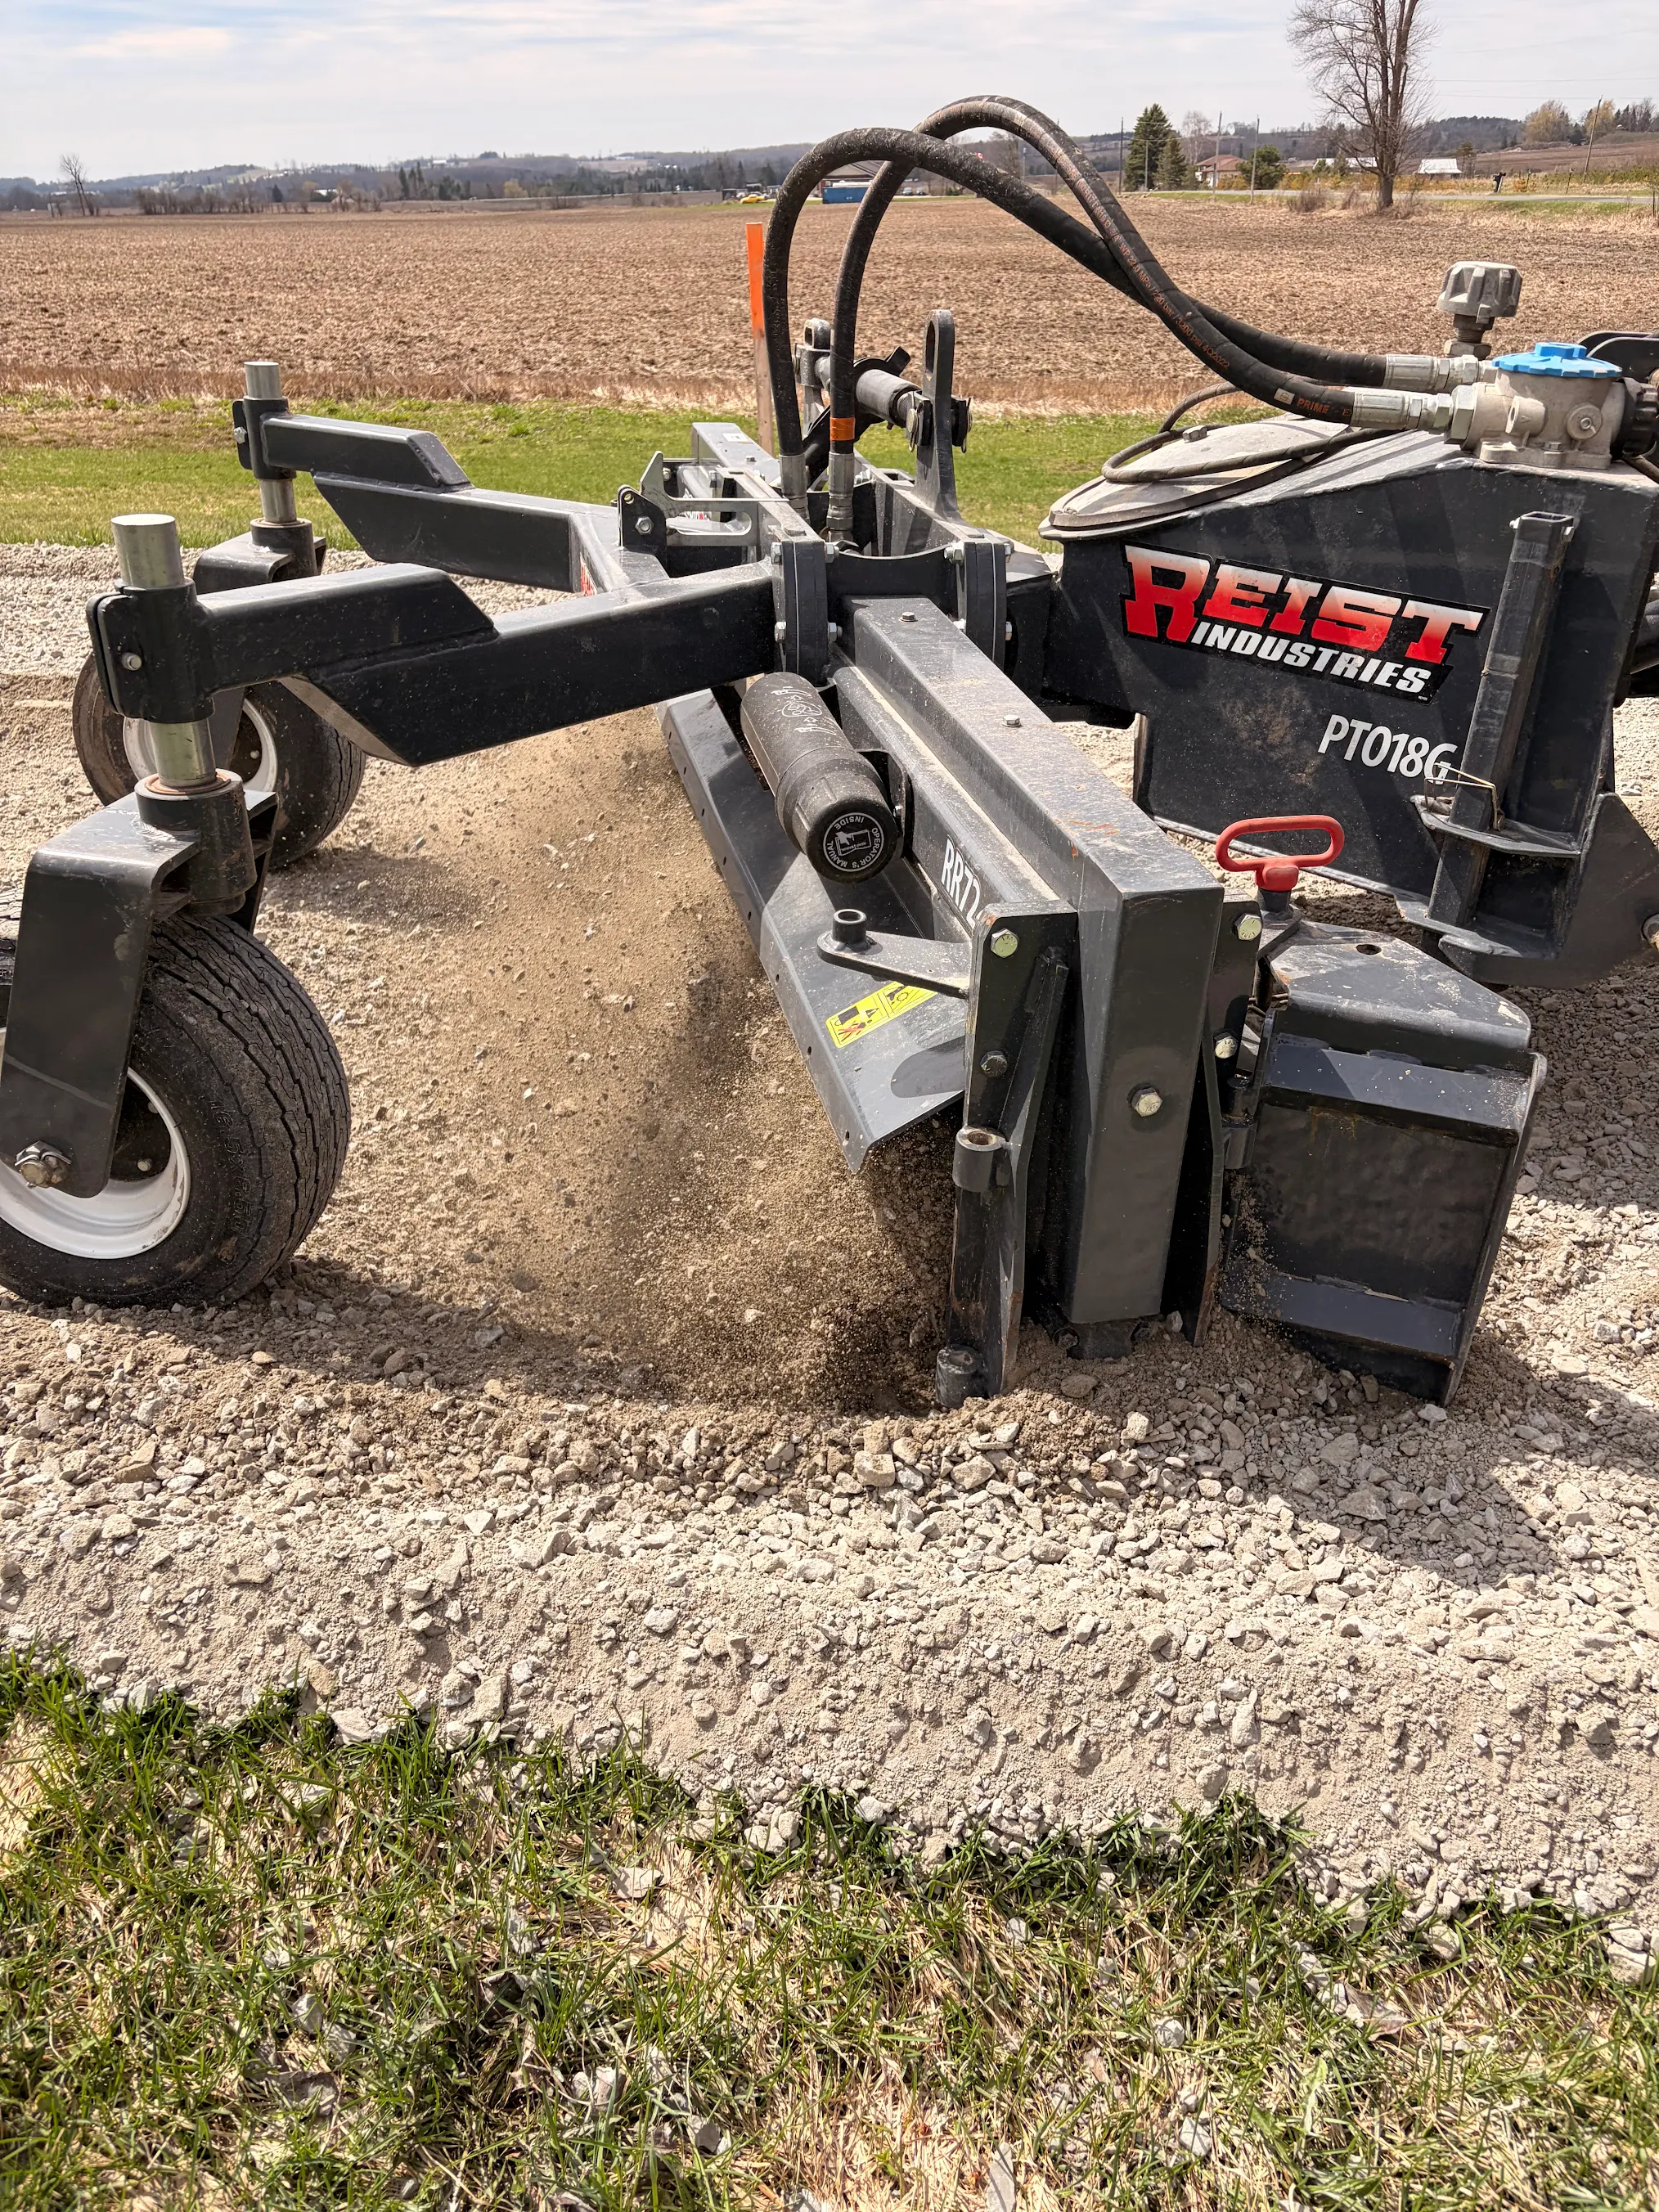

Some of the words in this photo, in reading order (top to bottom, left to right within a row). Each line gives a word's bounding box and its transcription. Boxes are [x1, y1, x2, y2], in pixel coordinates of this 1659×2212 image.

[1119, 242, 1130, 255] WP
[1139, 271, 1151, 288] MPa
[1153, 290, 1165, 305] 220
[1162, 302, 1175, 317] bar
[1176, 318, 1193, 337] 3200
[1190, 335, 1203, 347] psi
[1297, 398, 1330, 414] PRIME
[1125, 545, 1483, 665] REIST
[1191, 621, 1431, 694] INDUSTRIES
[834, 816, 864, 830] INSIDE
[852, 828, 880, 868] OPERATOR'S
[827, 841, 847, 867] MANUAL
[941, 838, 983, 929] RR72
